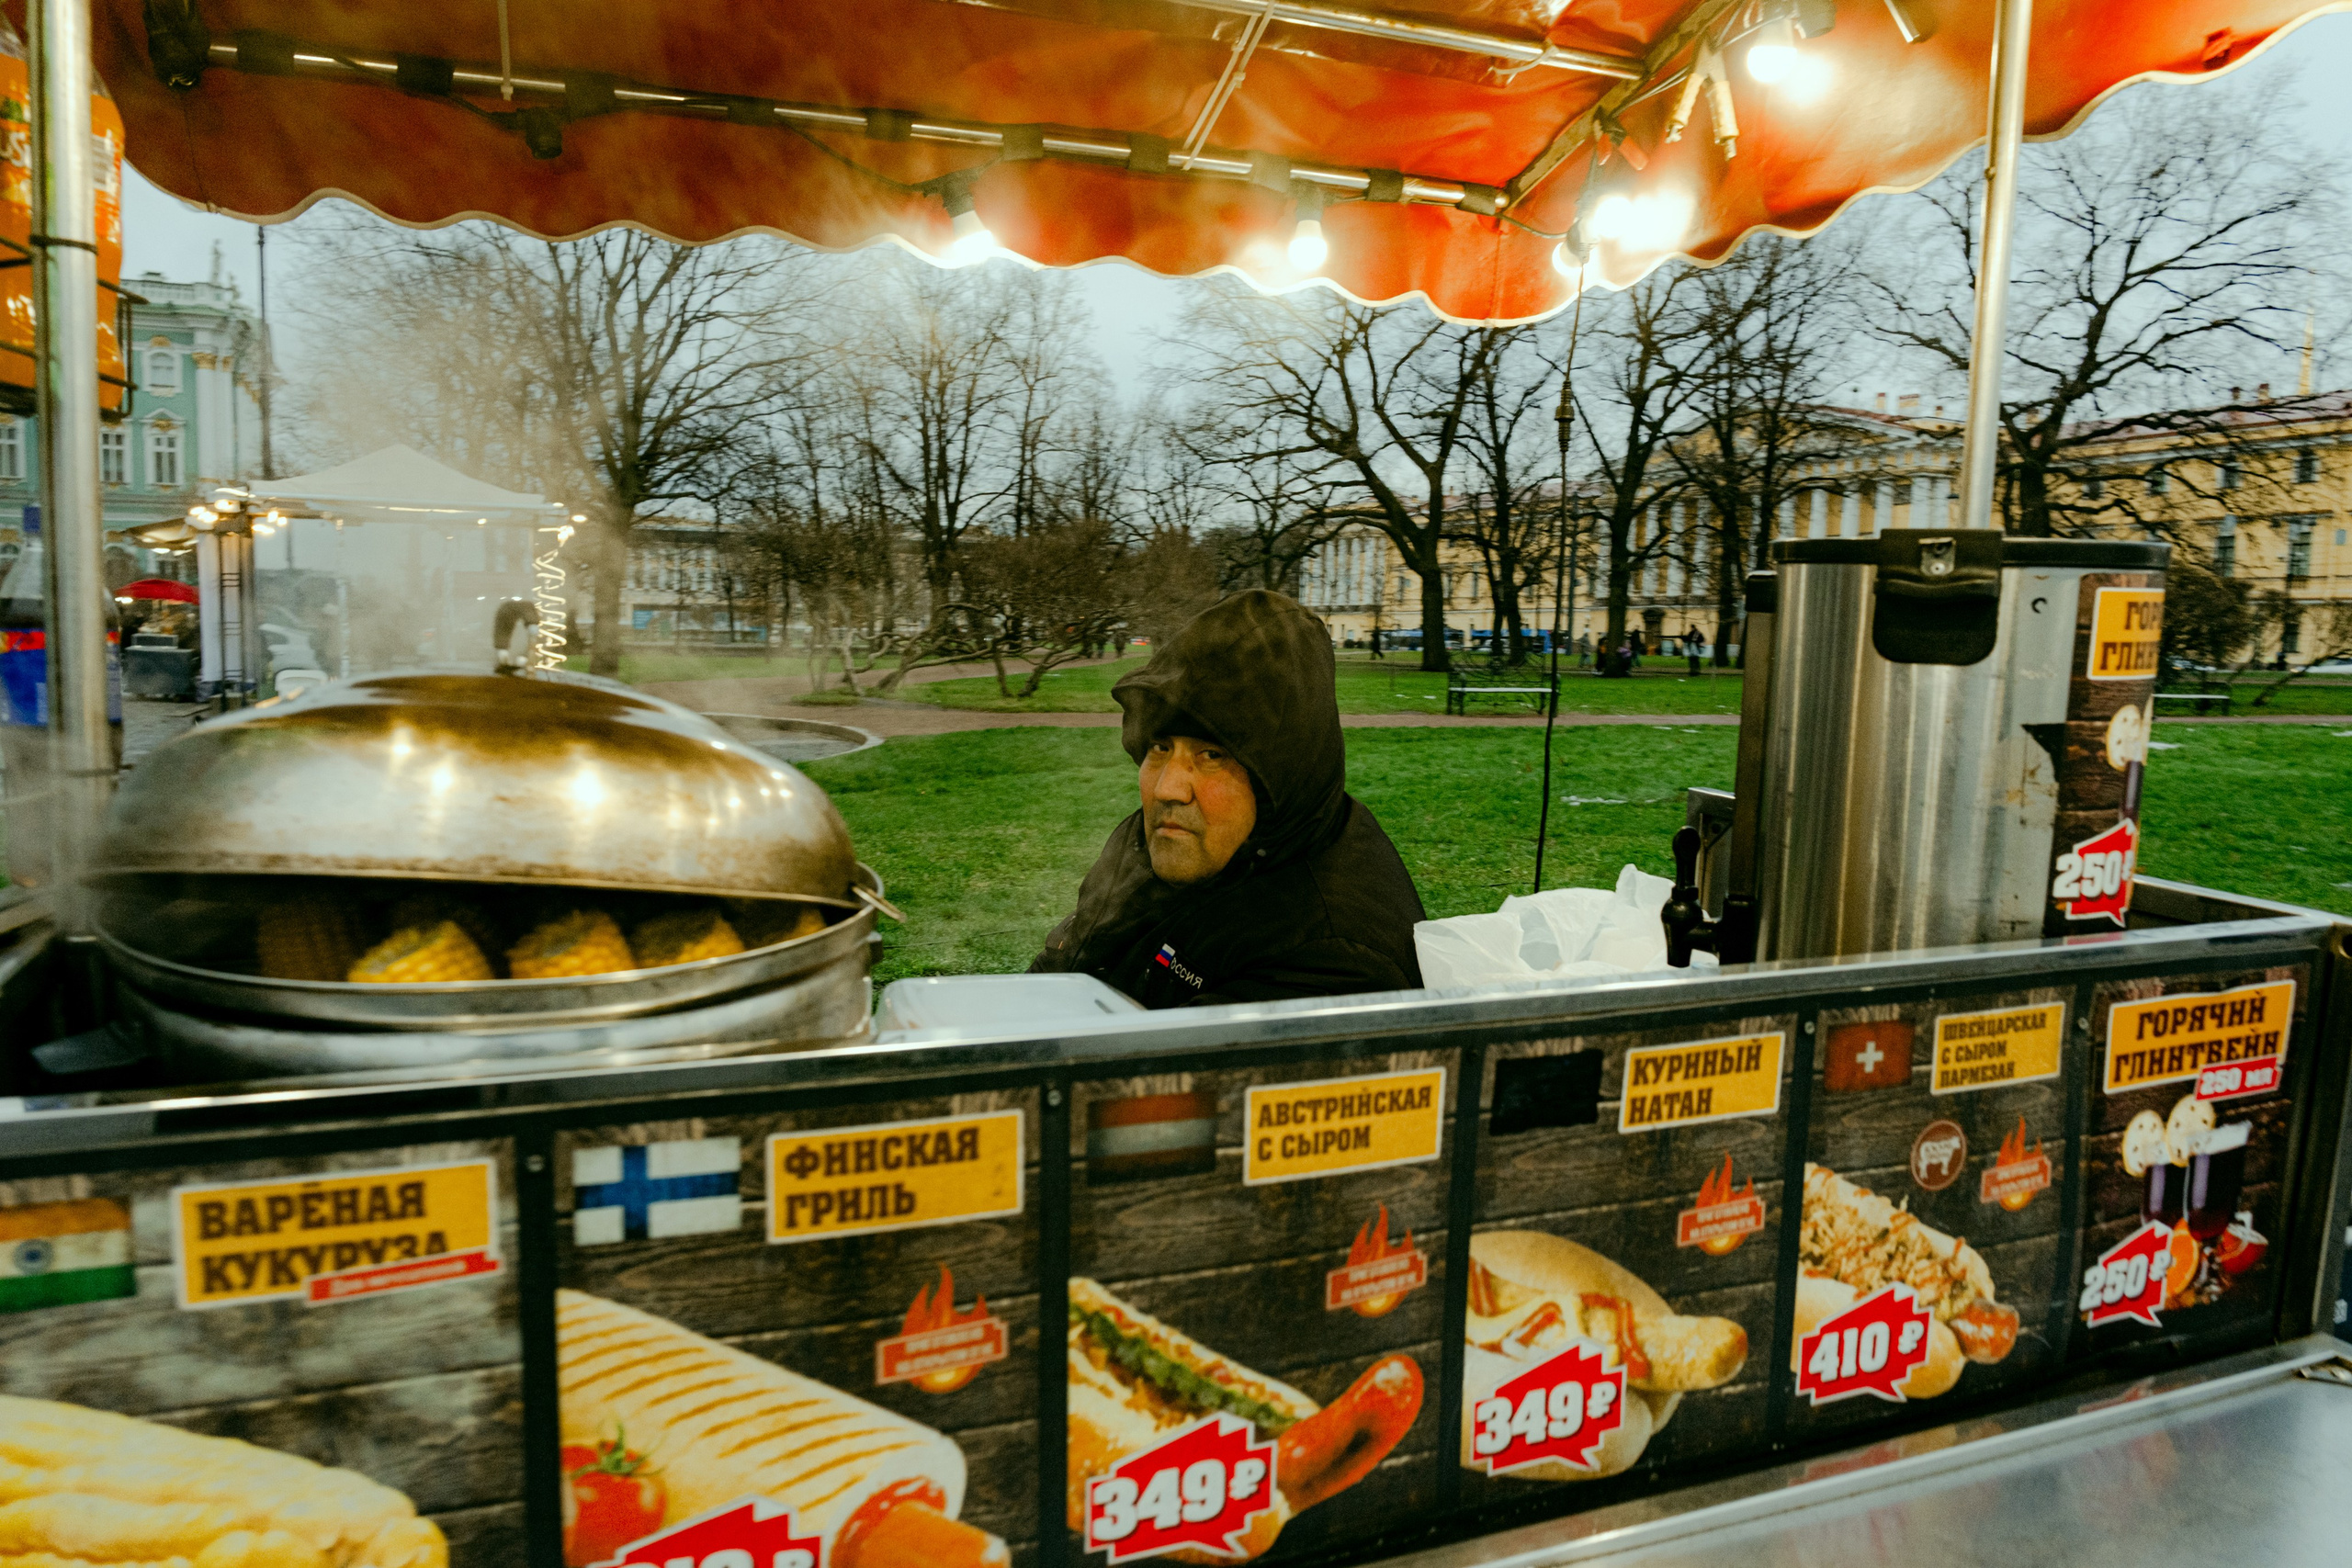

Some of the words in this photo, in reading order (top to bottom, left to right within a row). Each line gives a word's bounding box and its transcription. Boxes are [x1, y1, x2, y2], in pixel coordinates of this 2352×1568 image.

[1170, 957, 1204, 989] ОССИЯ
[1943, 1012, 2047, 1041] ШВЕЙЦАРСКАЯ
[2137, 990, 2267, 1040] ГОРЯЧИЙ
[1633, 1038, 1763, 1086] КУРИНЫЙ
[1941, 1047, 1951, 1065] С
[1955, 1040, 2007, 1063] СЫРОМ
[2114, 1028, 2279, 1082] ГЛИНТВЕЙН
[1940, 1060, 2015, 1088] ПАРМЕЗАН
[2199, 1067, 2242, 1095] 250
[1258, 1086, 1431, 1128] АВСТРИЙСКАЯ
[1629, 1087, 1713, 1124] НАТАН
[784, 1126, 979, 1180] ФИНСКАЯ
[1258, 1137, 1272, 1161] С
[1281, 1125, 1371, 1159] СЫРОМ
[197, 1181, 426, 1240] ВАРЁНАЯ
[786, 1181, 917, 1229] ГРИЛЬ
